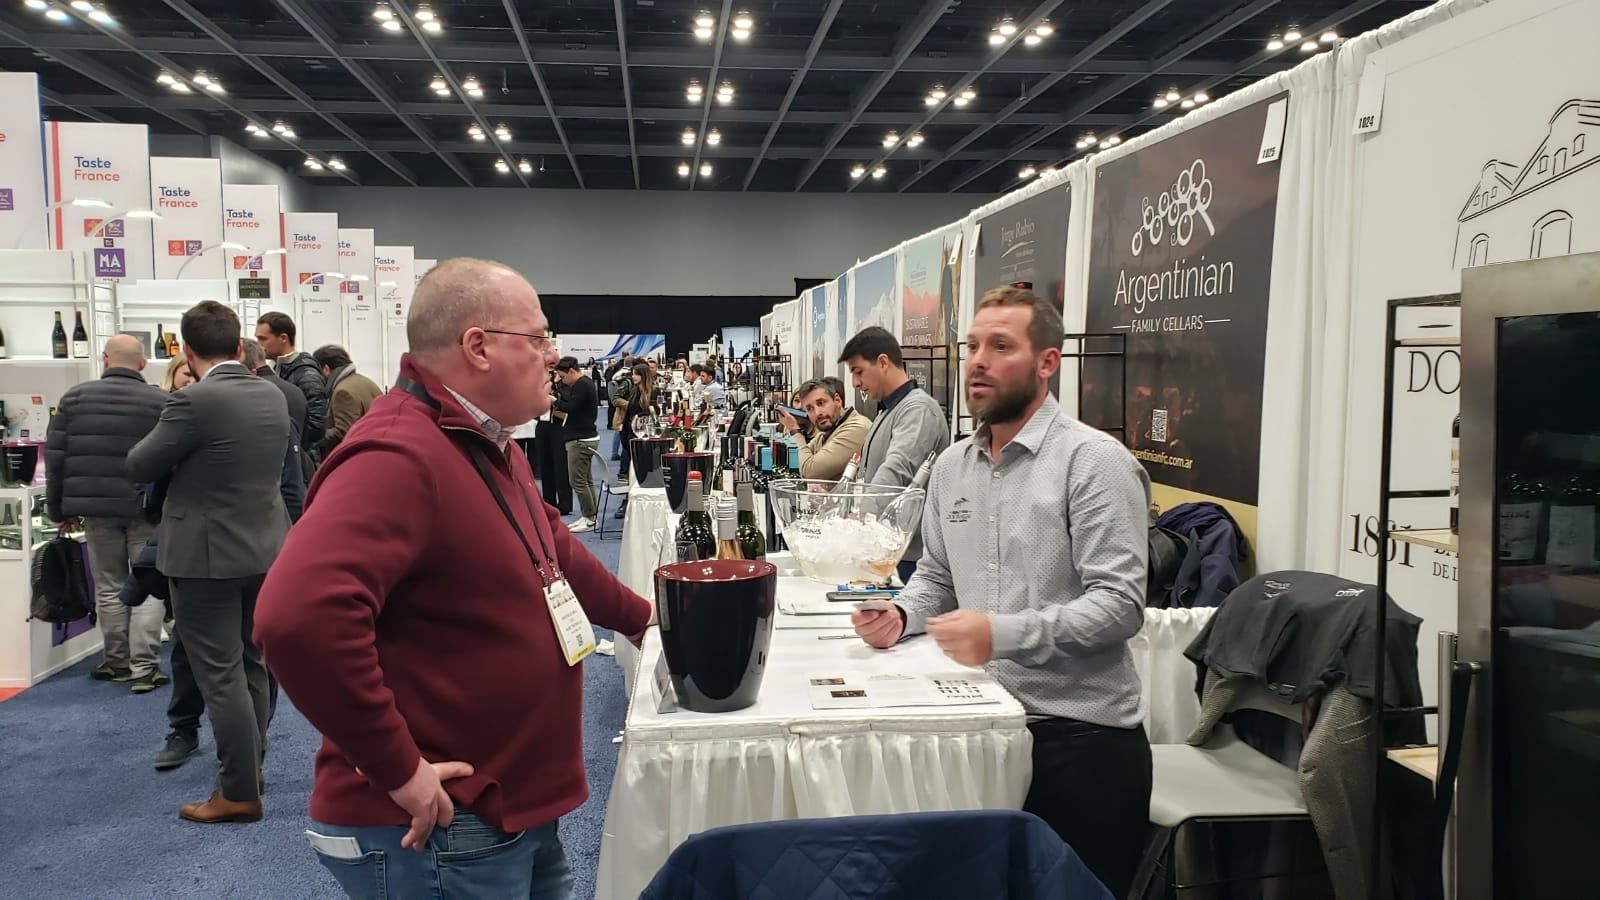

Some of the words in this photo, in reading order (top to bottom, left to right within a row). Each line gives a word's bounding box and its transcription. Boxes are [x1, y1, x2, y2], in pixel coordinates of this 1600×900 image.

[74, 156, 111, 168] Taste
[74, 169, 120, 181] France
[158, 186, 190, 197] Taste
[159, 197, 198, 208] France
[226, 209, 253, 218] Taste
[226, 219, 260, 228] France
[293, 233, 316, 242] Taste
[293, 241, 321, 250] France
[99, 253, 121, 268] MA
[375, 257, 396, 265] Taste
[1113, 255, 1234, 314] Argentinian
[1131, 317, 1161, 333] FAMILY
[1163, 315, 1204, 331] CELLARS
[1432, 561, 1450, 580] DE
